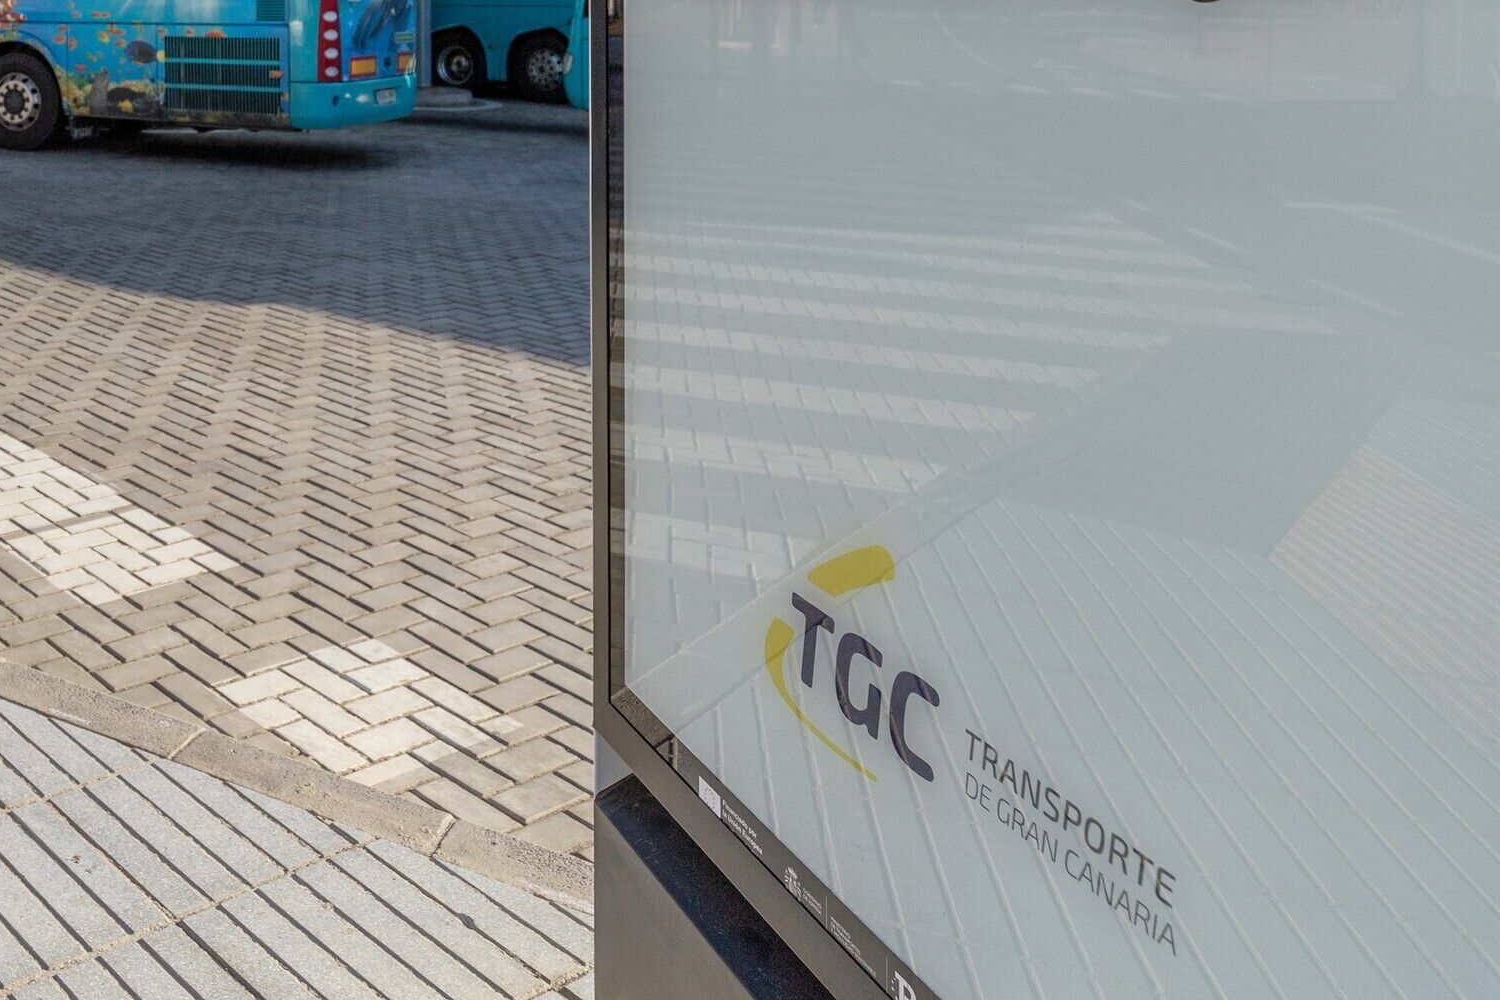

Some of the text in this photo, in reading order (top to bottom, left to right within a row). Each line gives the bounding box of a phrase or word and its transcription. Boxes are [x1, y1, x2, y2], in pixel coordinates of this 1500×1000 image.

[791, 591, 940, 782] TGC
[965, 728, 1177, 908] TRANSPORTE
[965, 772, 1177, 957] DE GRAN CANARIA
